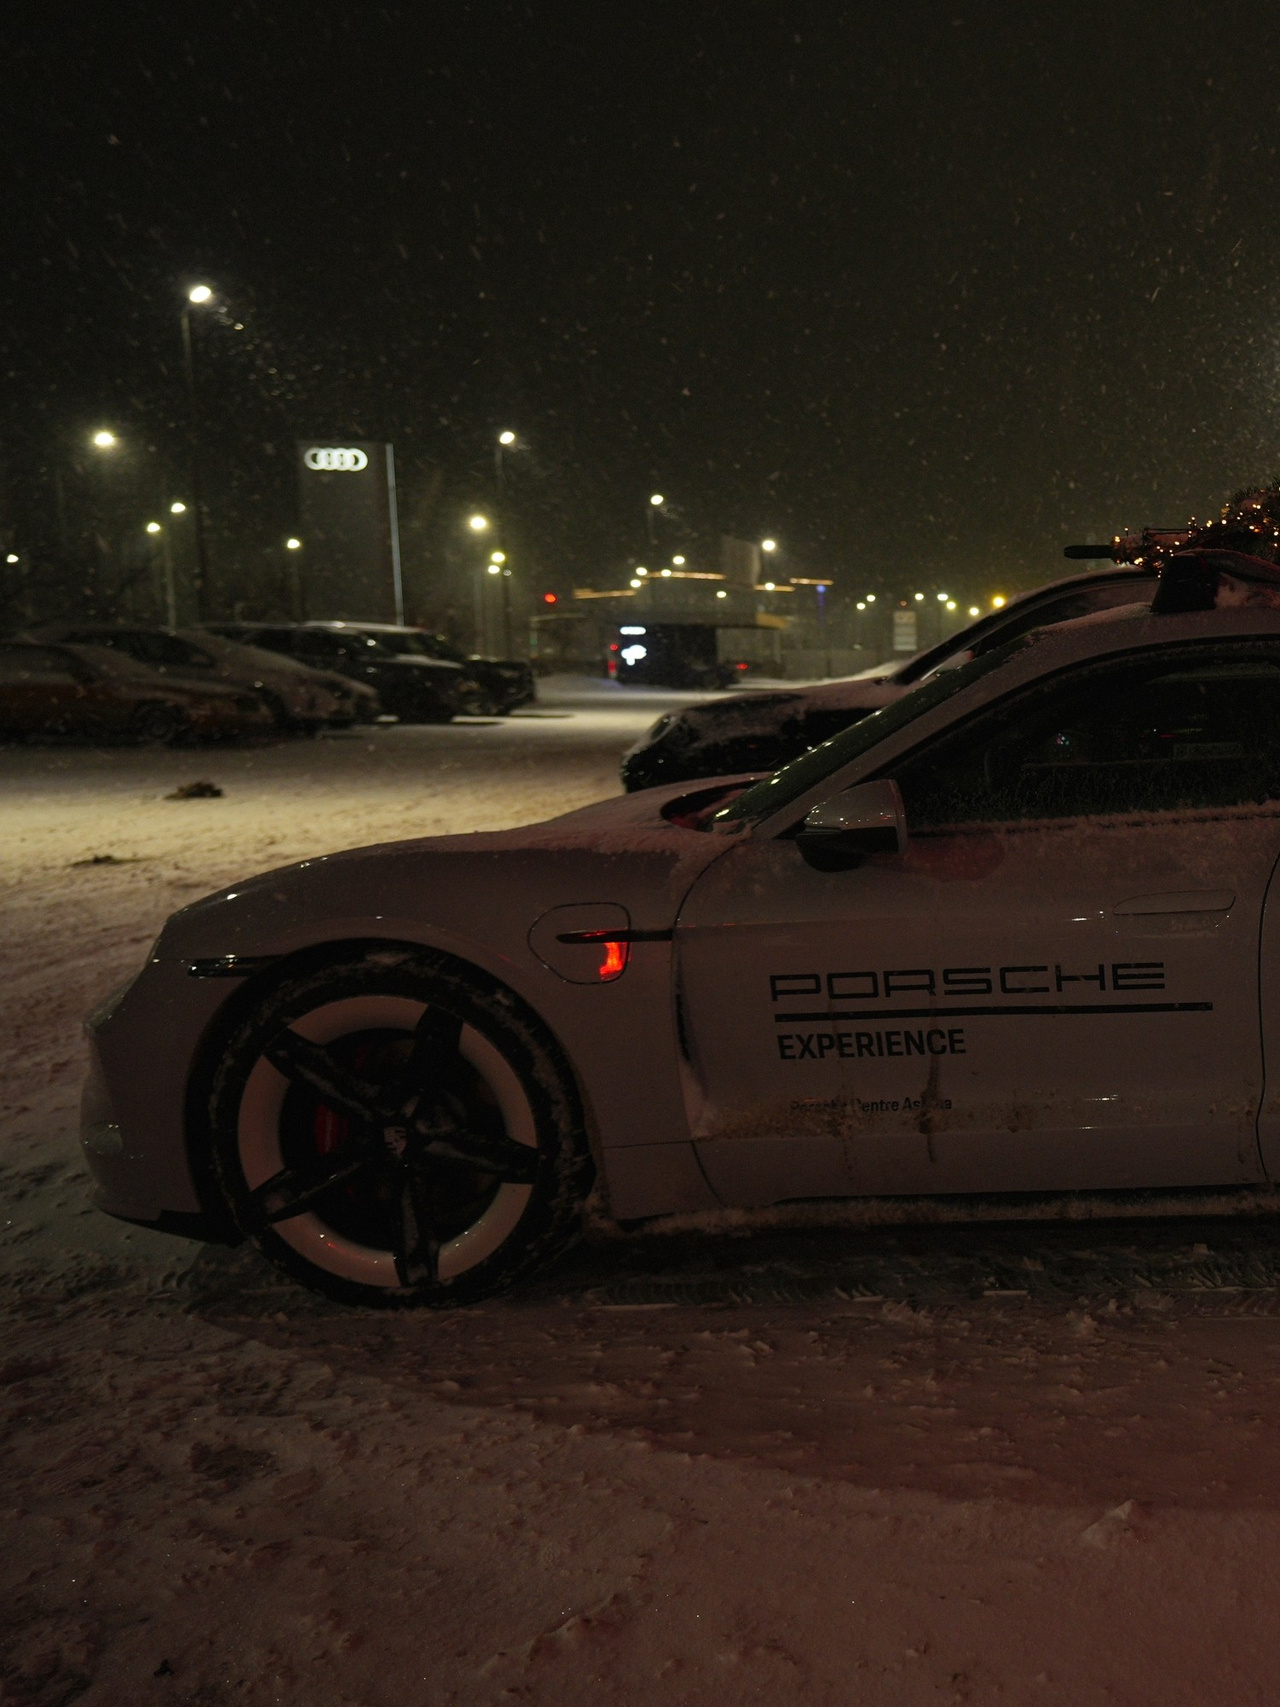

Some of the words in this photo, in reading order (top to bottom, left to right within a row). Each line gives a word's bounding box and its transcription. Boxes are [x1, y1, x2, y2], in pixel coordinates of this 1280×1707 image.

[770, 963, 1166, 1001] PORSCHE
[778, 1028, 967, 1060] EXPERIENCE
[853, 1099, 901, 1112] entre
[902, 1096, 953, 1111] Asa
